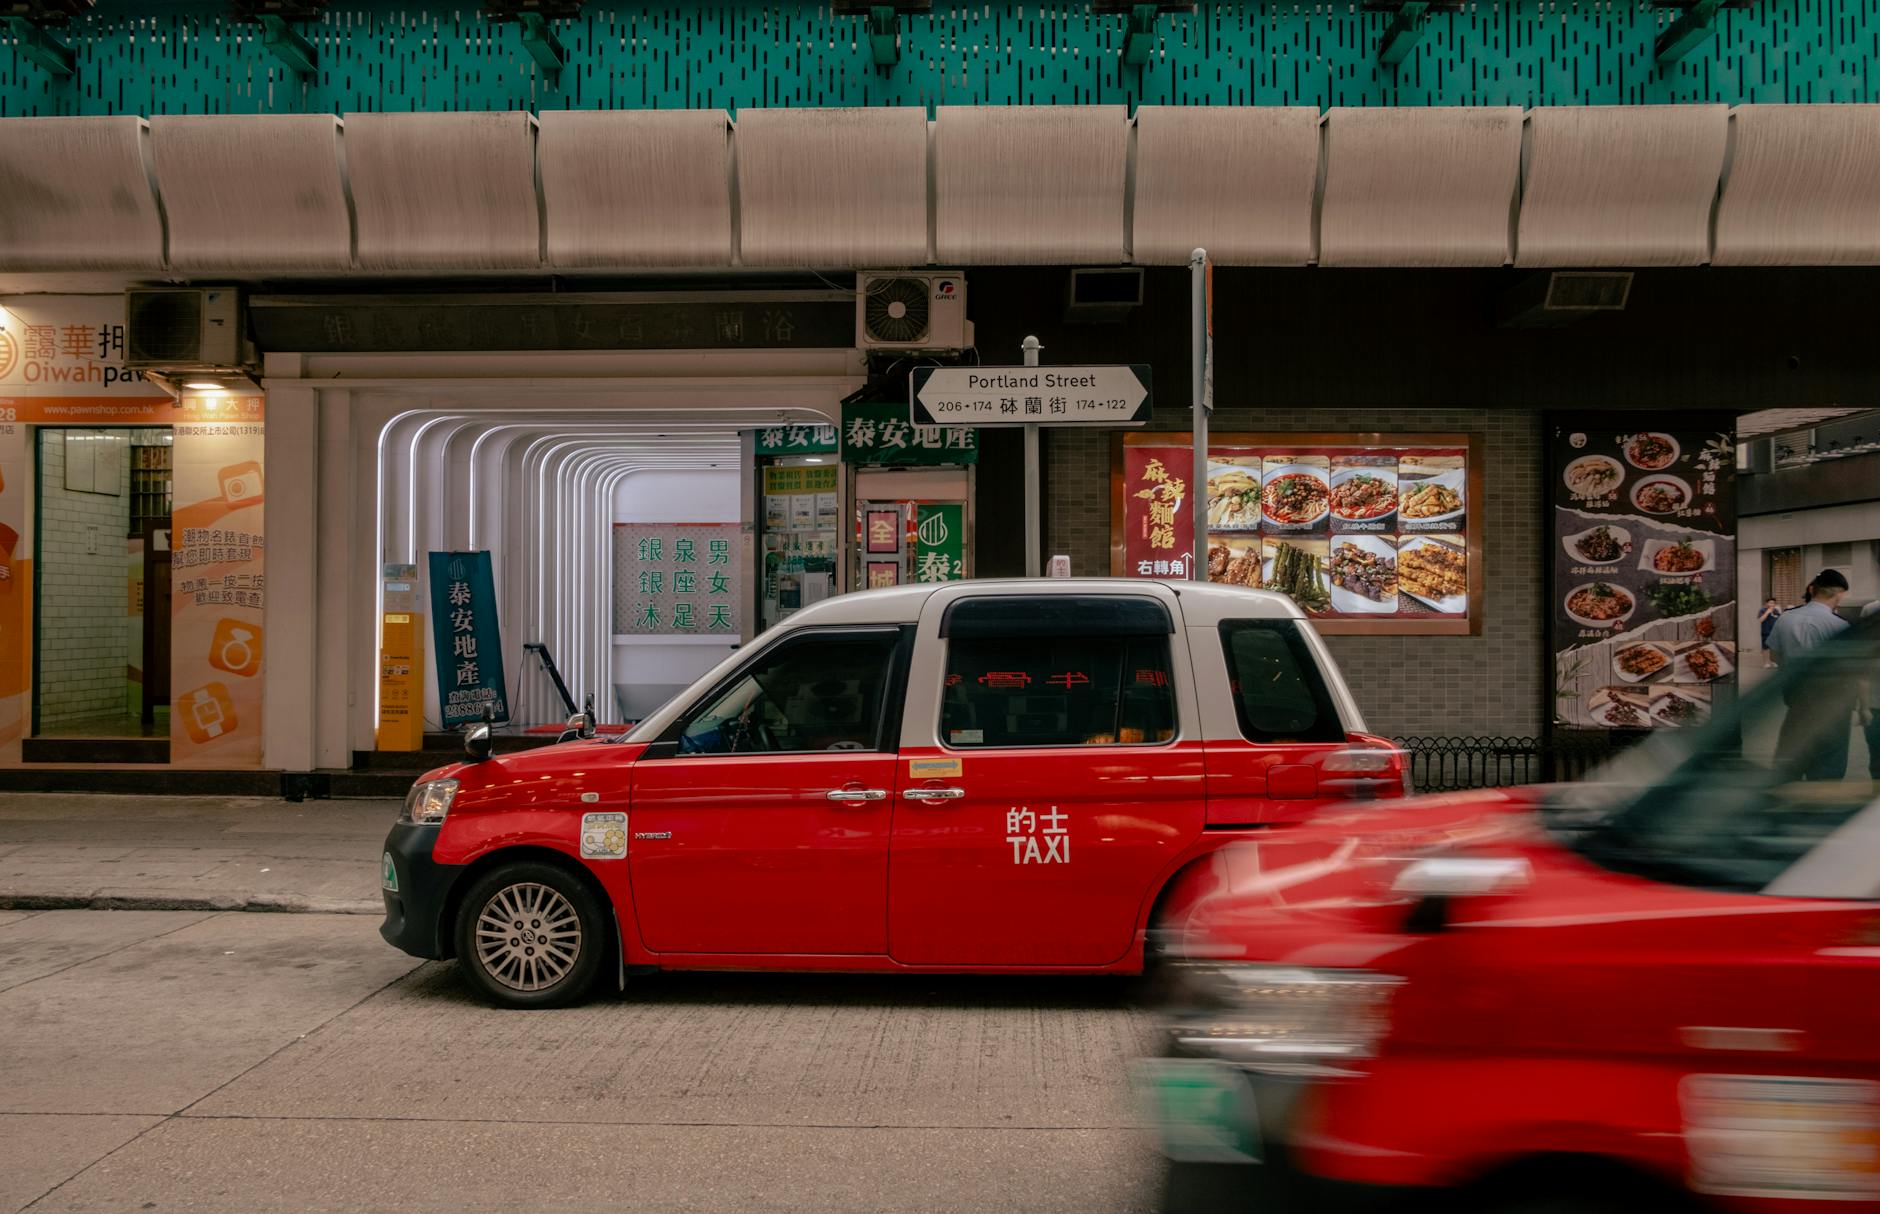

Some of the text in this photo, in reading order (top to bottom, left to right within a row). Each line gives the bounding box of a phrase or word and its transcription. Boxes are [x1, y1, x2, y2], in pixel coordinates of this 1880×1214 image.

[968, 373, 1096, 389] Portland Street
[44, 405, 155, 416] www.pawnshop.com.hk
[1000, 396, 1067, 415] 砵蘭街
[846, 418, 976, 449] 泰安地產
[1142, 458, 1185, 549] 麻辣麵館
[1137, 559, 1185, 576] 右轉角
[195, 590, 264, 607] 歡迎致電查
[449, 582, 481, 686] 泰安地產
[1006, 805, 1069, 834] 的士
[1005, 835, 1070, 864] TAXI
